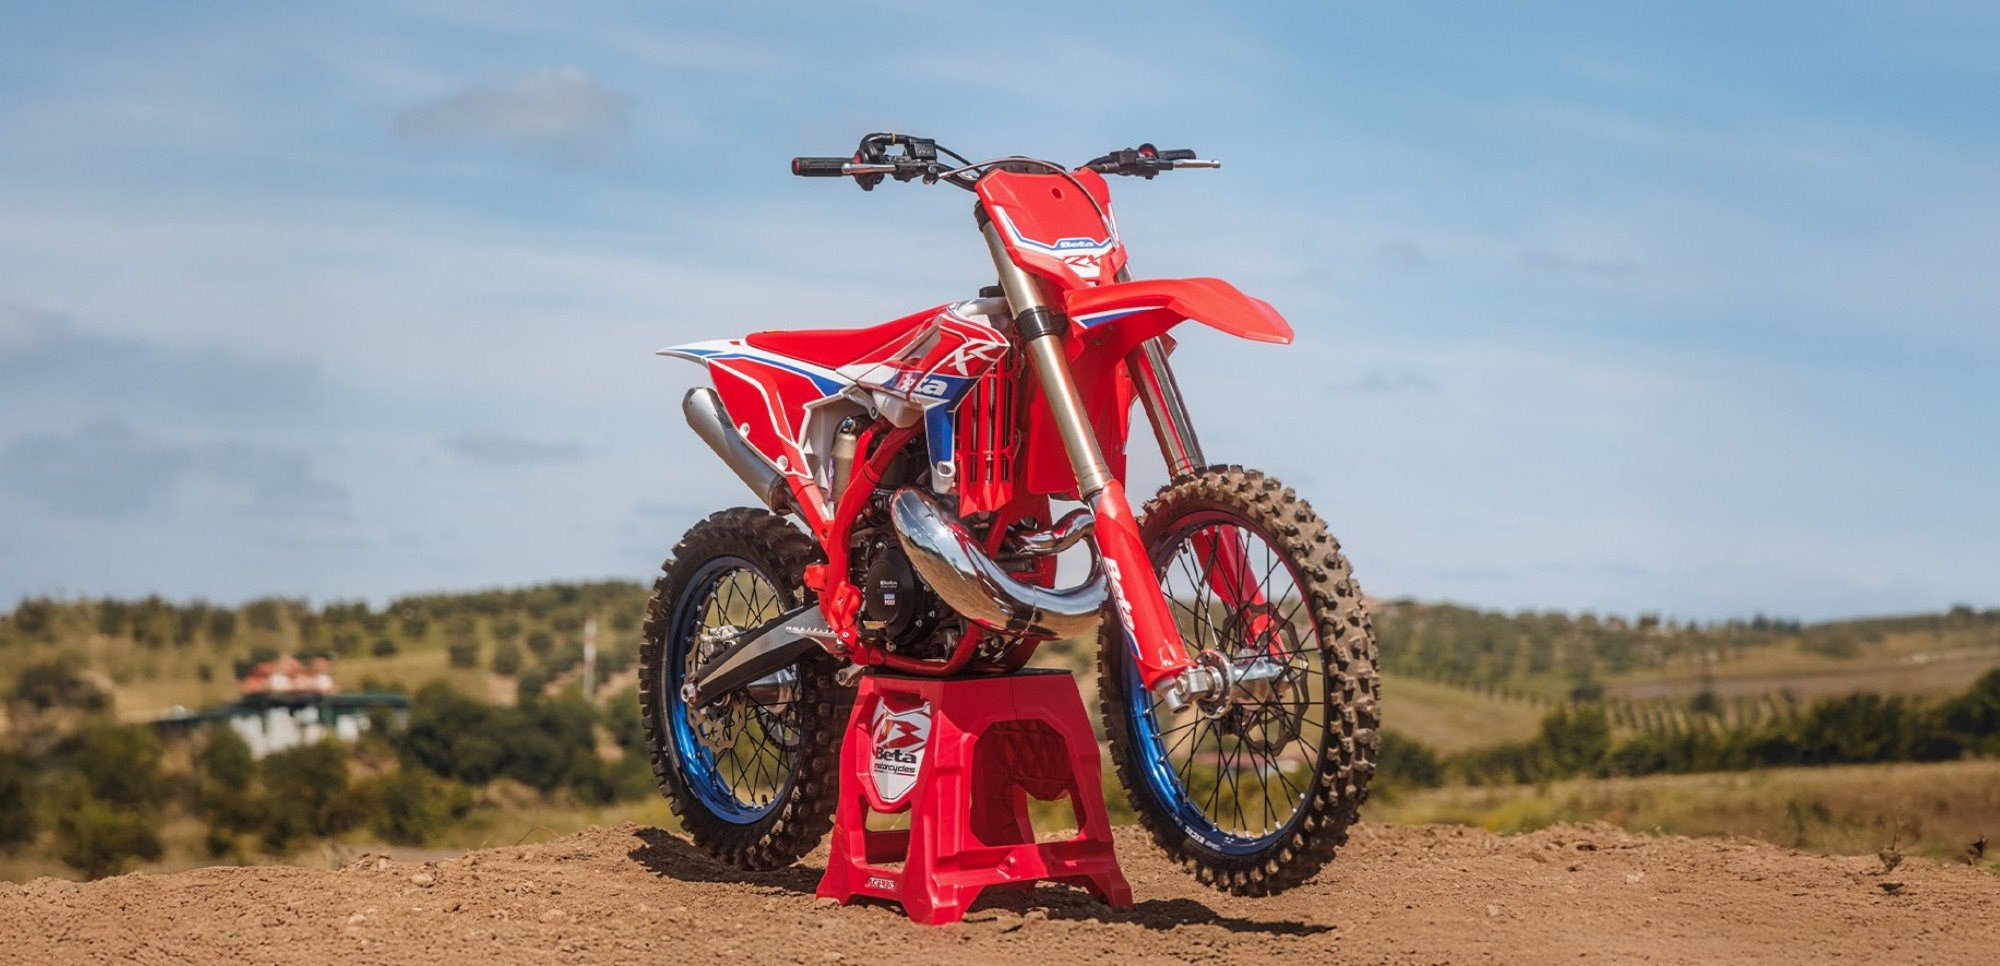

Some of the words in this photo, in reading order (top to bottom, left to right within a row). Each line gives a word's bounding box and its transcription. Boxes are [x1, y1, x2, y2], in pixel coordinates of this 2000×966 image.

[1060, 241, 1094, 249] Beta
[1103, 556, 1135, 631] Beta
[875, 746, 917, 764] Beta
[874, 762, 916, 774] motorcycles
